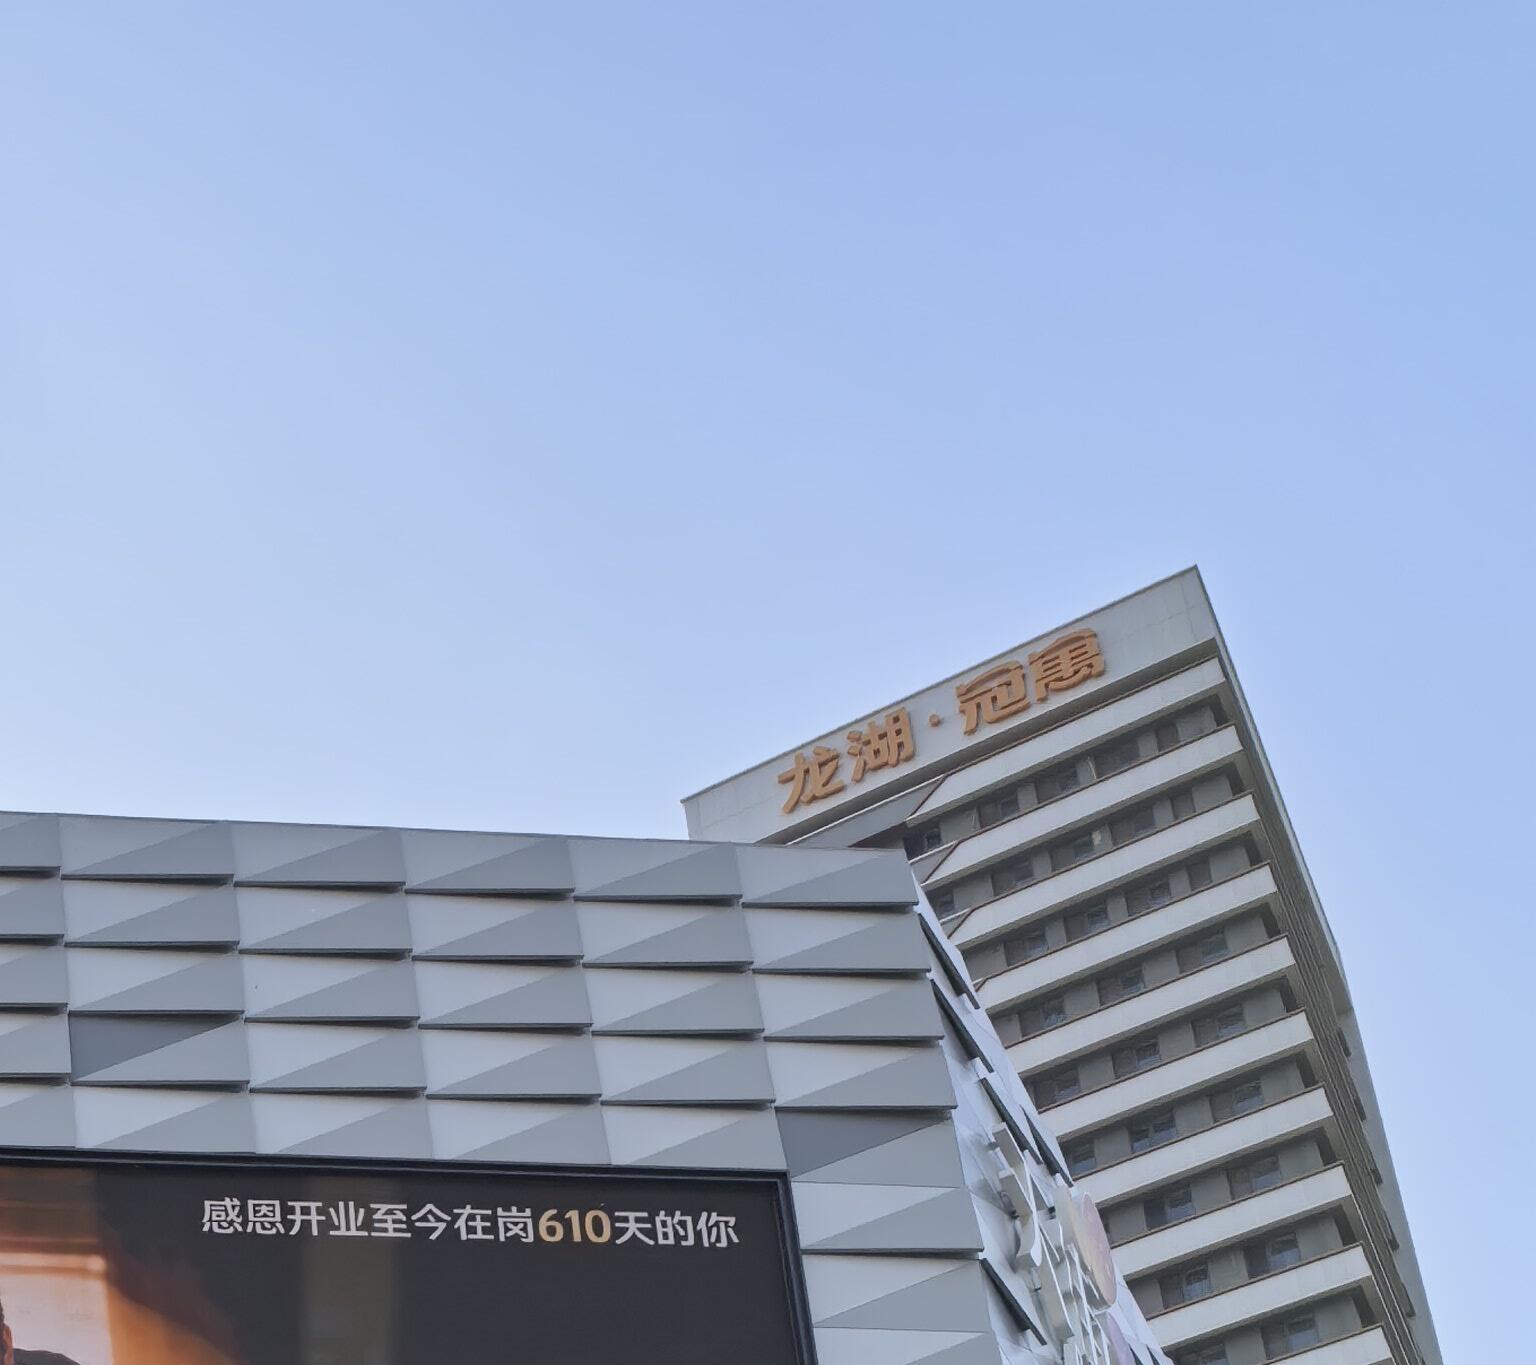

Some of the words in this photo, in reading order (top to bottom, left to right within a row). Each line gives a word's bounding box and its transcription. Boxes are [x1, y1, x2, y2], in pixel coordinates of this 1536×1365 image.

[201, 1197, 739, 1249] 感恩开业至今在岗610天的你
